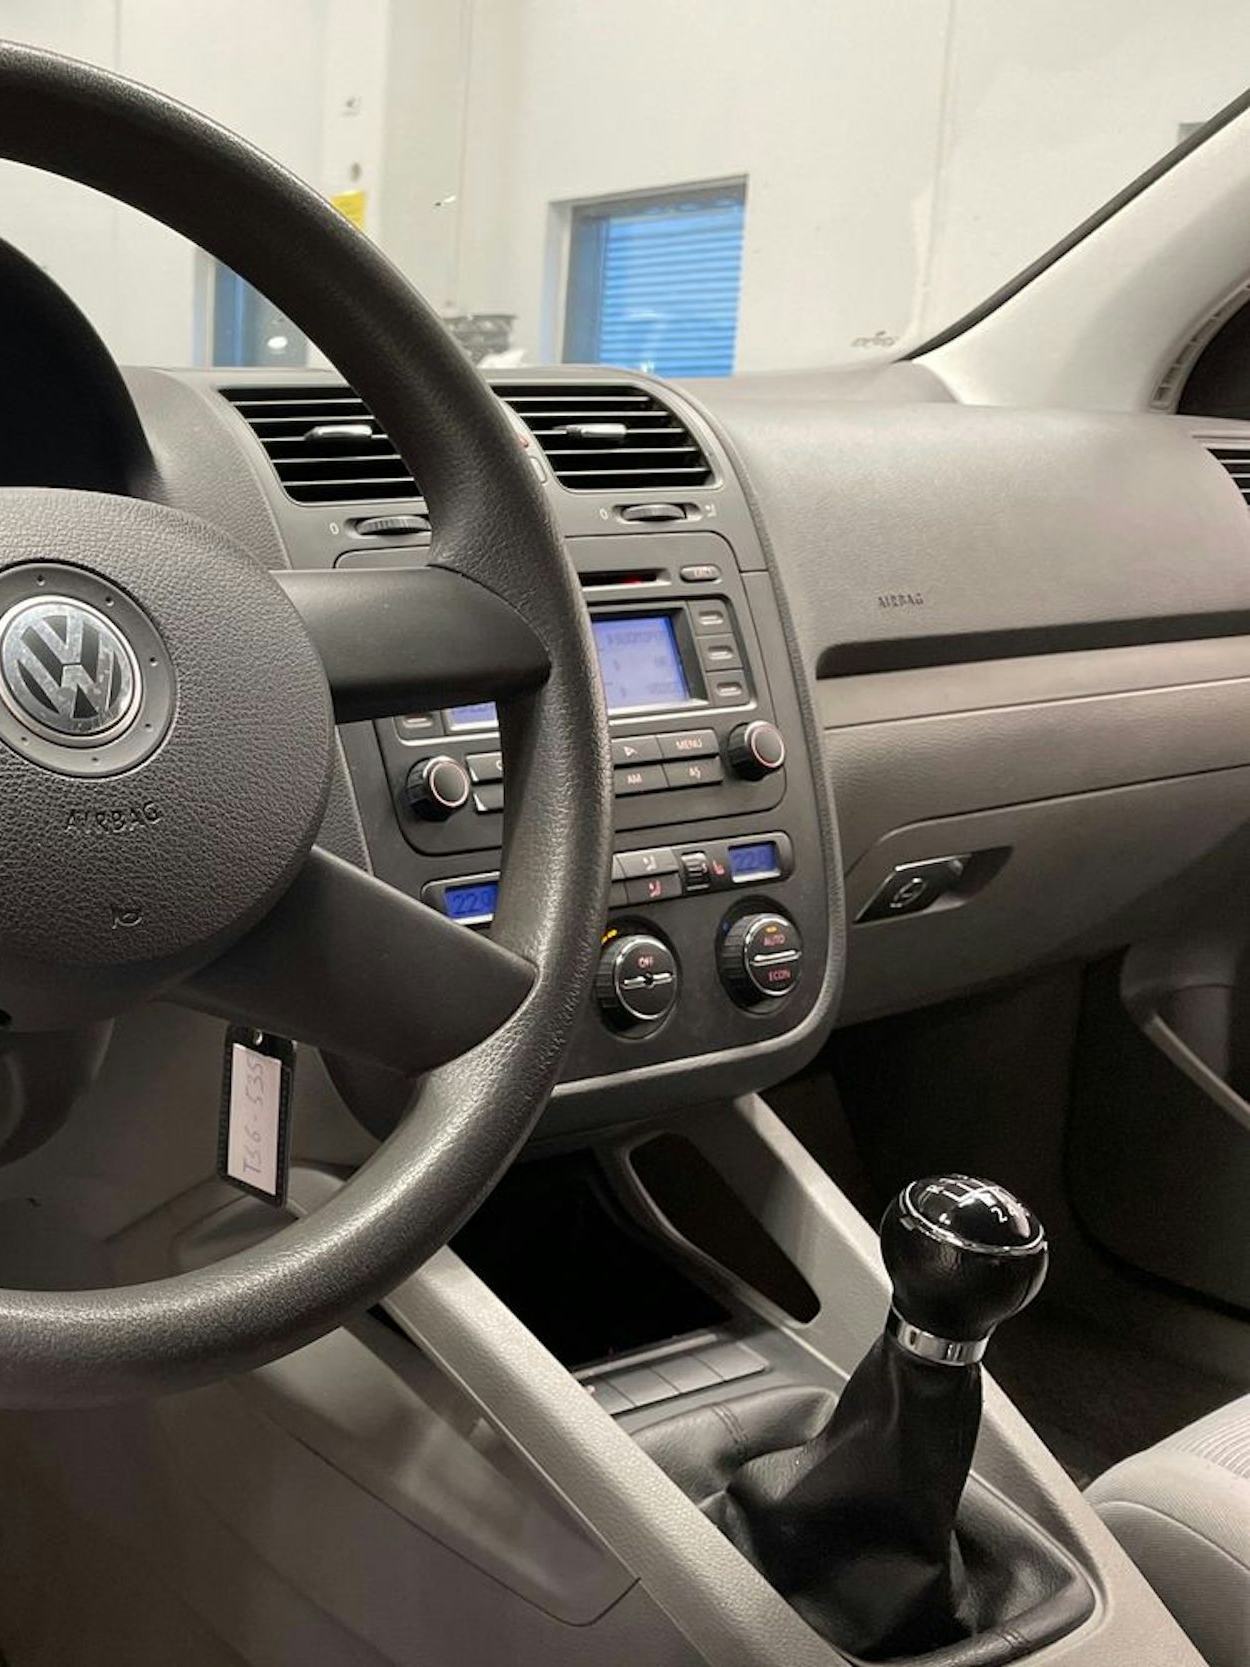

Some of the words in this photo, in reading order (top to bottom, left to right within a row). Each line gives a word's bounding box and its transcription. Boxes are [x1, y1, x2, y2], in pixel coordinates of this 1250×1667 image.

[675, 738, 703, 750] MENU
[627, 773, 642, 784] AM
[64, 800, 161, 834] AIRBAG
[764, 934, 786, 947] AUTO
[638, 956, 654, 968] OFF
[768, 968, 792, 982] ECON
